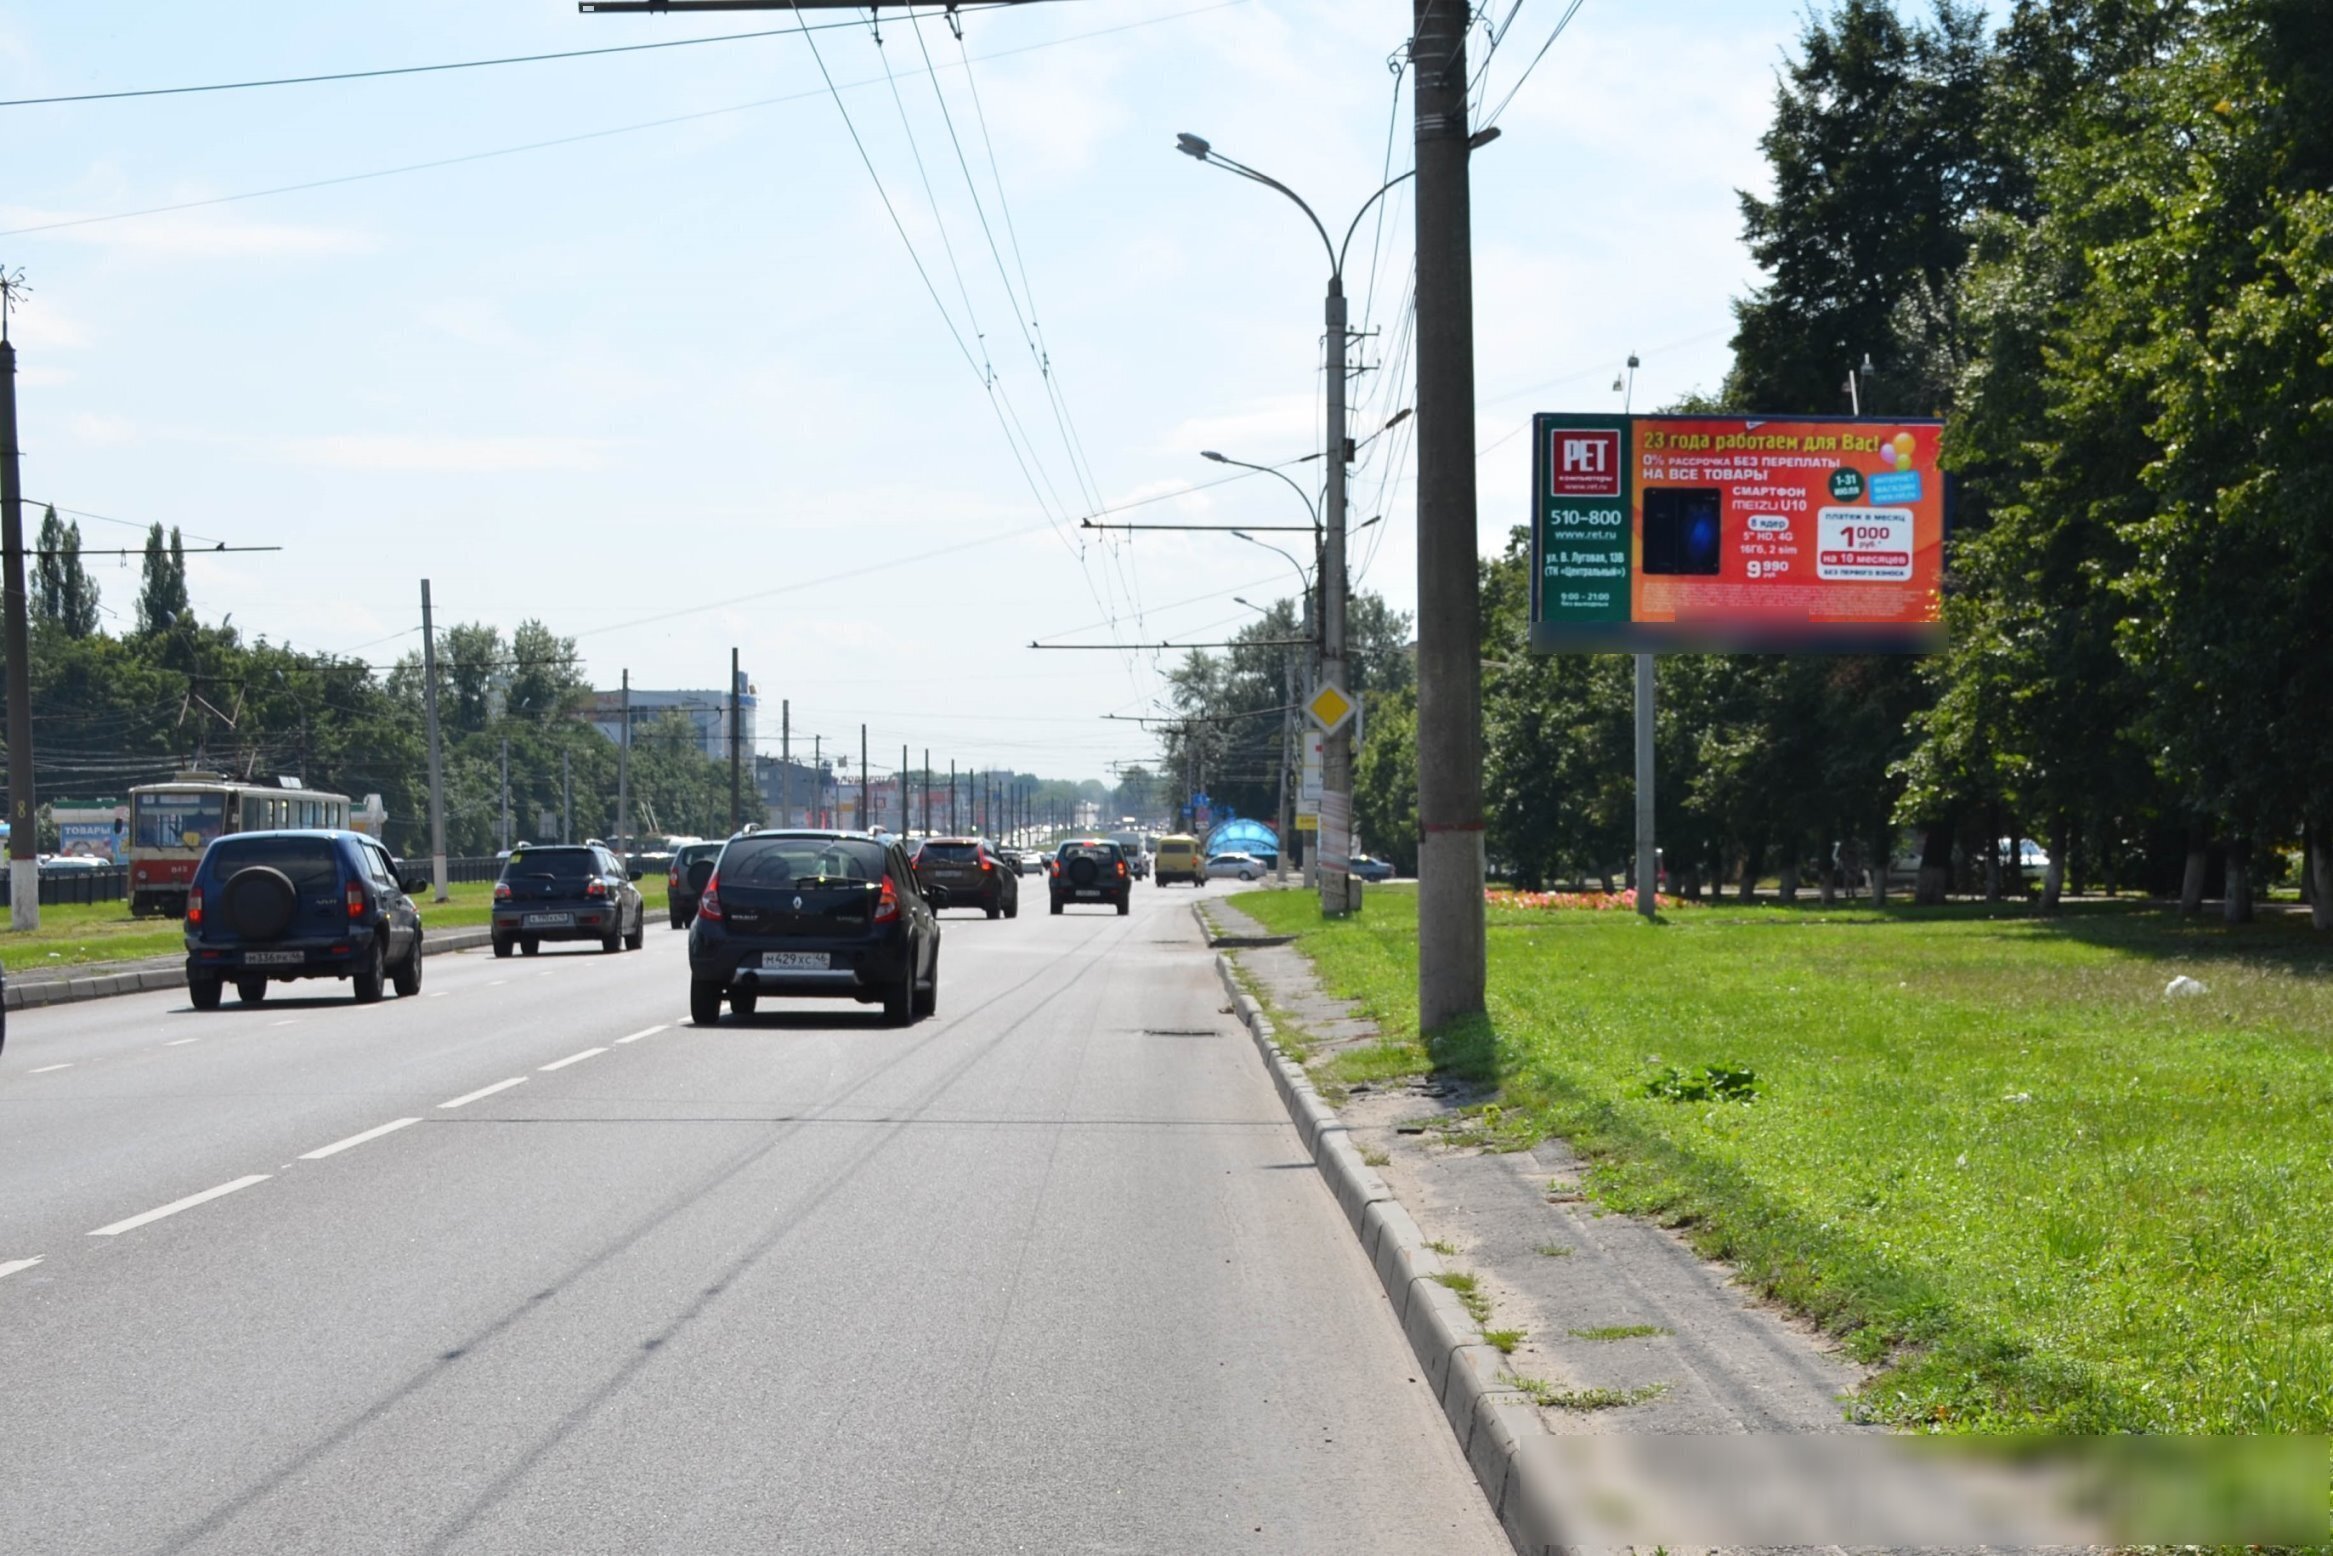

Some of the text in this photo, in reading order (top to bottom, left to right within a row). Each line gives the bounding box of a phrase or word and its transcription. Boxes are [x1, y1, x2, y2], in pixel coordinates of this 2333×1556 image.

[1644, 432, 1880, 452] 23 года работаем для Вас!
[1563, 439, 1609, 472] РЕТ
[1642, 454, 1840, 468] 0% РАССРОЧКА БЕЗ ПЕРЕПЛАТЫ
[1642, 468, 1769, 481] НА ВСЕ ТОВАРЫ
[1835, 474, 1857, 485] 1-31
[1732, 487, 1806, 497] СМАРТФОН
[1834, 487, 1860, 496] ИЮЛЯ
[1732, 500, 1807, 511] MEIZU U10
[1760, 521, 1785, 529] ядер
[1555, 531, 1617, 540] www.ret.ru
[1778, 532, 1793, 541] 4G
[1769, 546, 1776, 554] 2
[1546, 552, 1559, 564] ул.
[1571, 552, 1607, 564] Луговая,
[1841, 554, 1854, 563] 10
[1857, 556, 1906, 565] месяцев
[18, 800, 26, 818] 8
[64, 826, 110, 835] ТОВАРЫ
